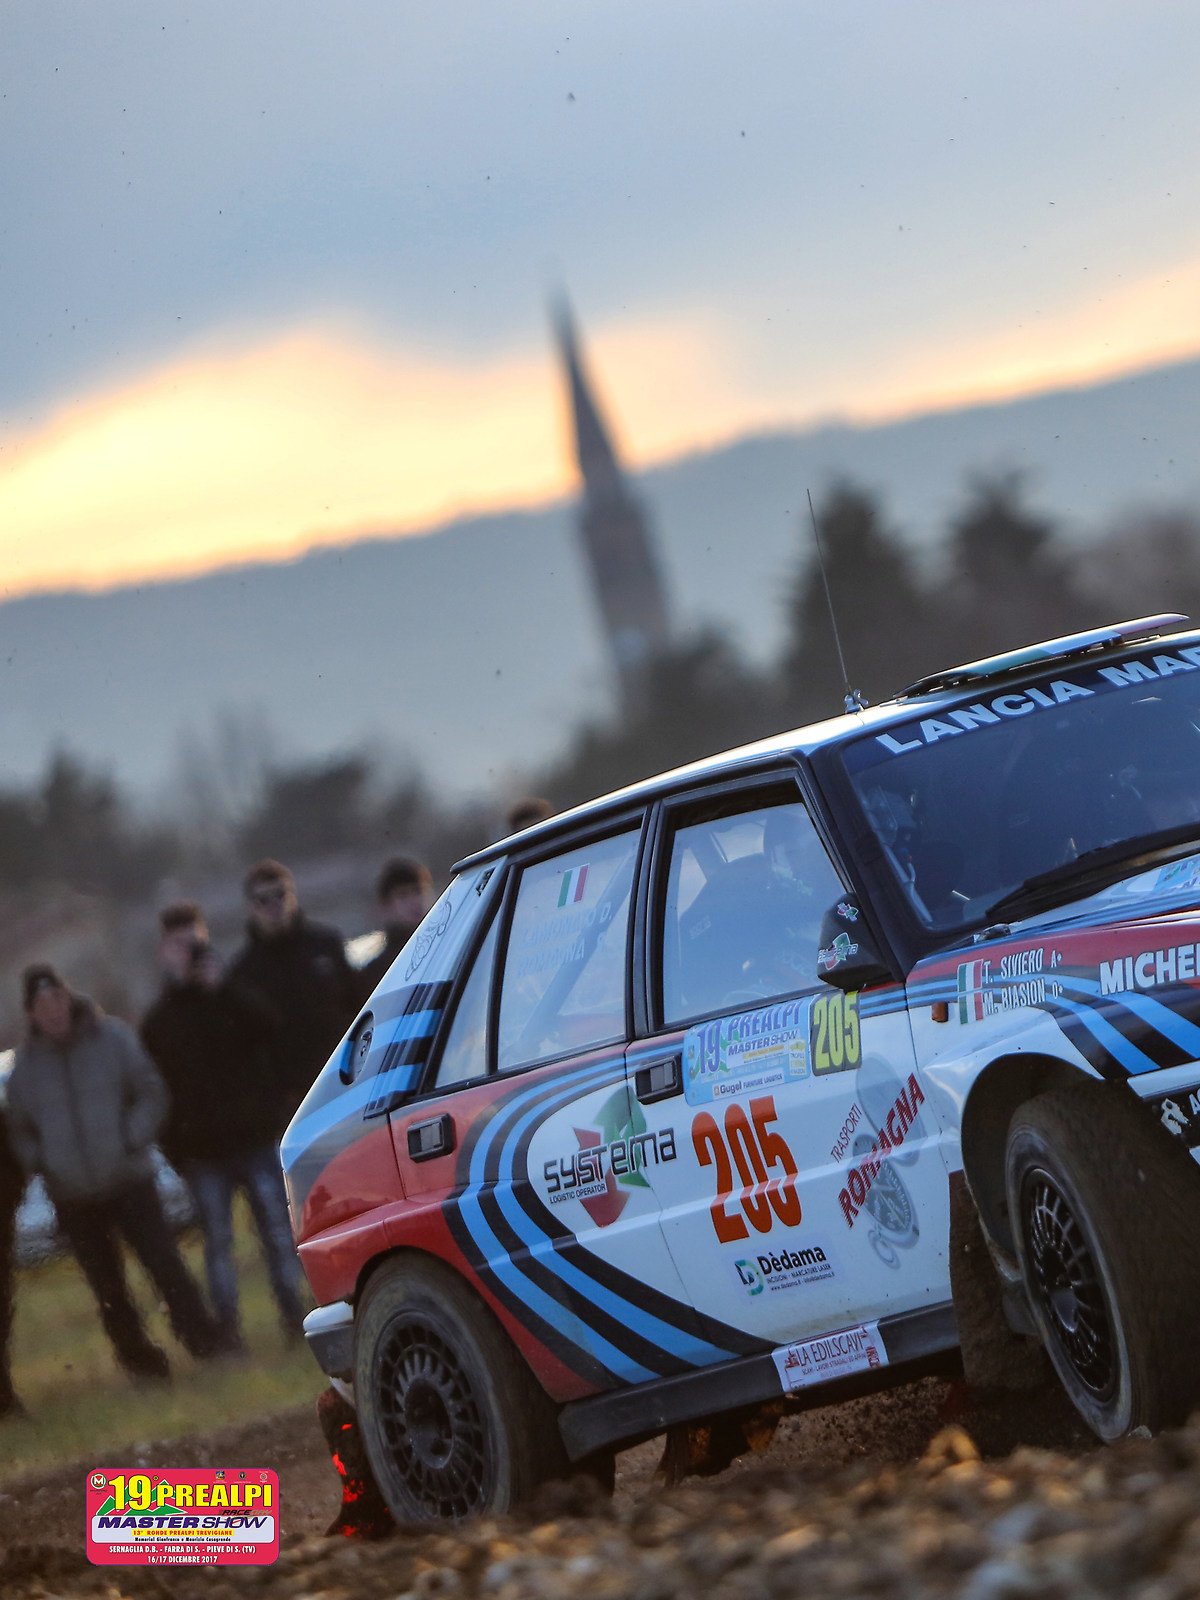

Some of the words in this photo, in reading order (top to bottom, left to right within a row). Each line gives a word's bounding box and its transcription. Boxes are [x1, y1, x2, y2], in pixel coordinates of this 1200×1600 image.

[875, 678, 1095, 755] LANCIA
[983, 961, 993, 984] T.
[1000, 947, 1044, 980] SIVIERO
[983, 992, 998, 1015] M.
[1001, 978, 1046, 1012] BIASION
[697, 1019, 722, 1075] 19
[727, 1000, 803, 1042] PREALPI
[728, 1036, 770, 1056] MASTER
[770, 1029, 798, 1046] SHOW
[813, 990, 859, 1070] 205
[719, 1080, 742, 1095] Gugel
[830, 1102, 863, 1164] TRASPORTI
[838, 1072, 926, 1229] ROMAGNA
[691, 1094, 802, 1244] 205
[549, 1187, 575, 1204] LOGISTIC
[576, 1183, 606, 1200] OPERATOR
[757, 1246, 826, 1275] Dèdama
[795, 1347, 812, 1366] LA
[813, 1330, 864, 1363] EDILSCAVI
